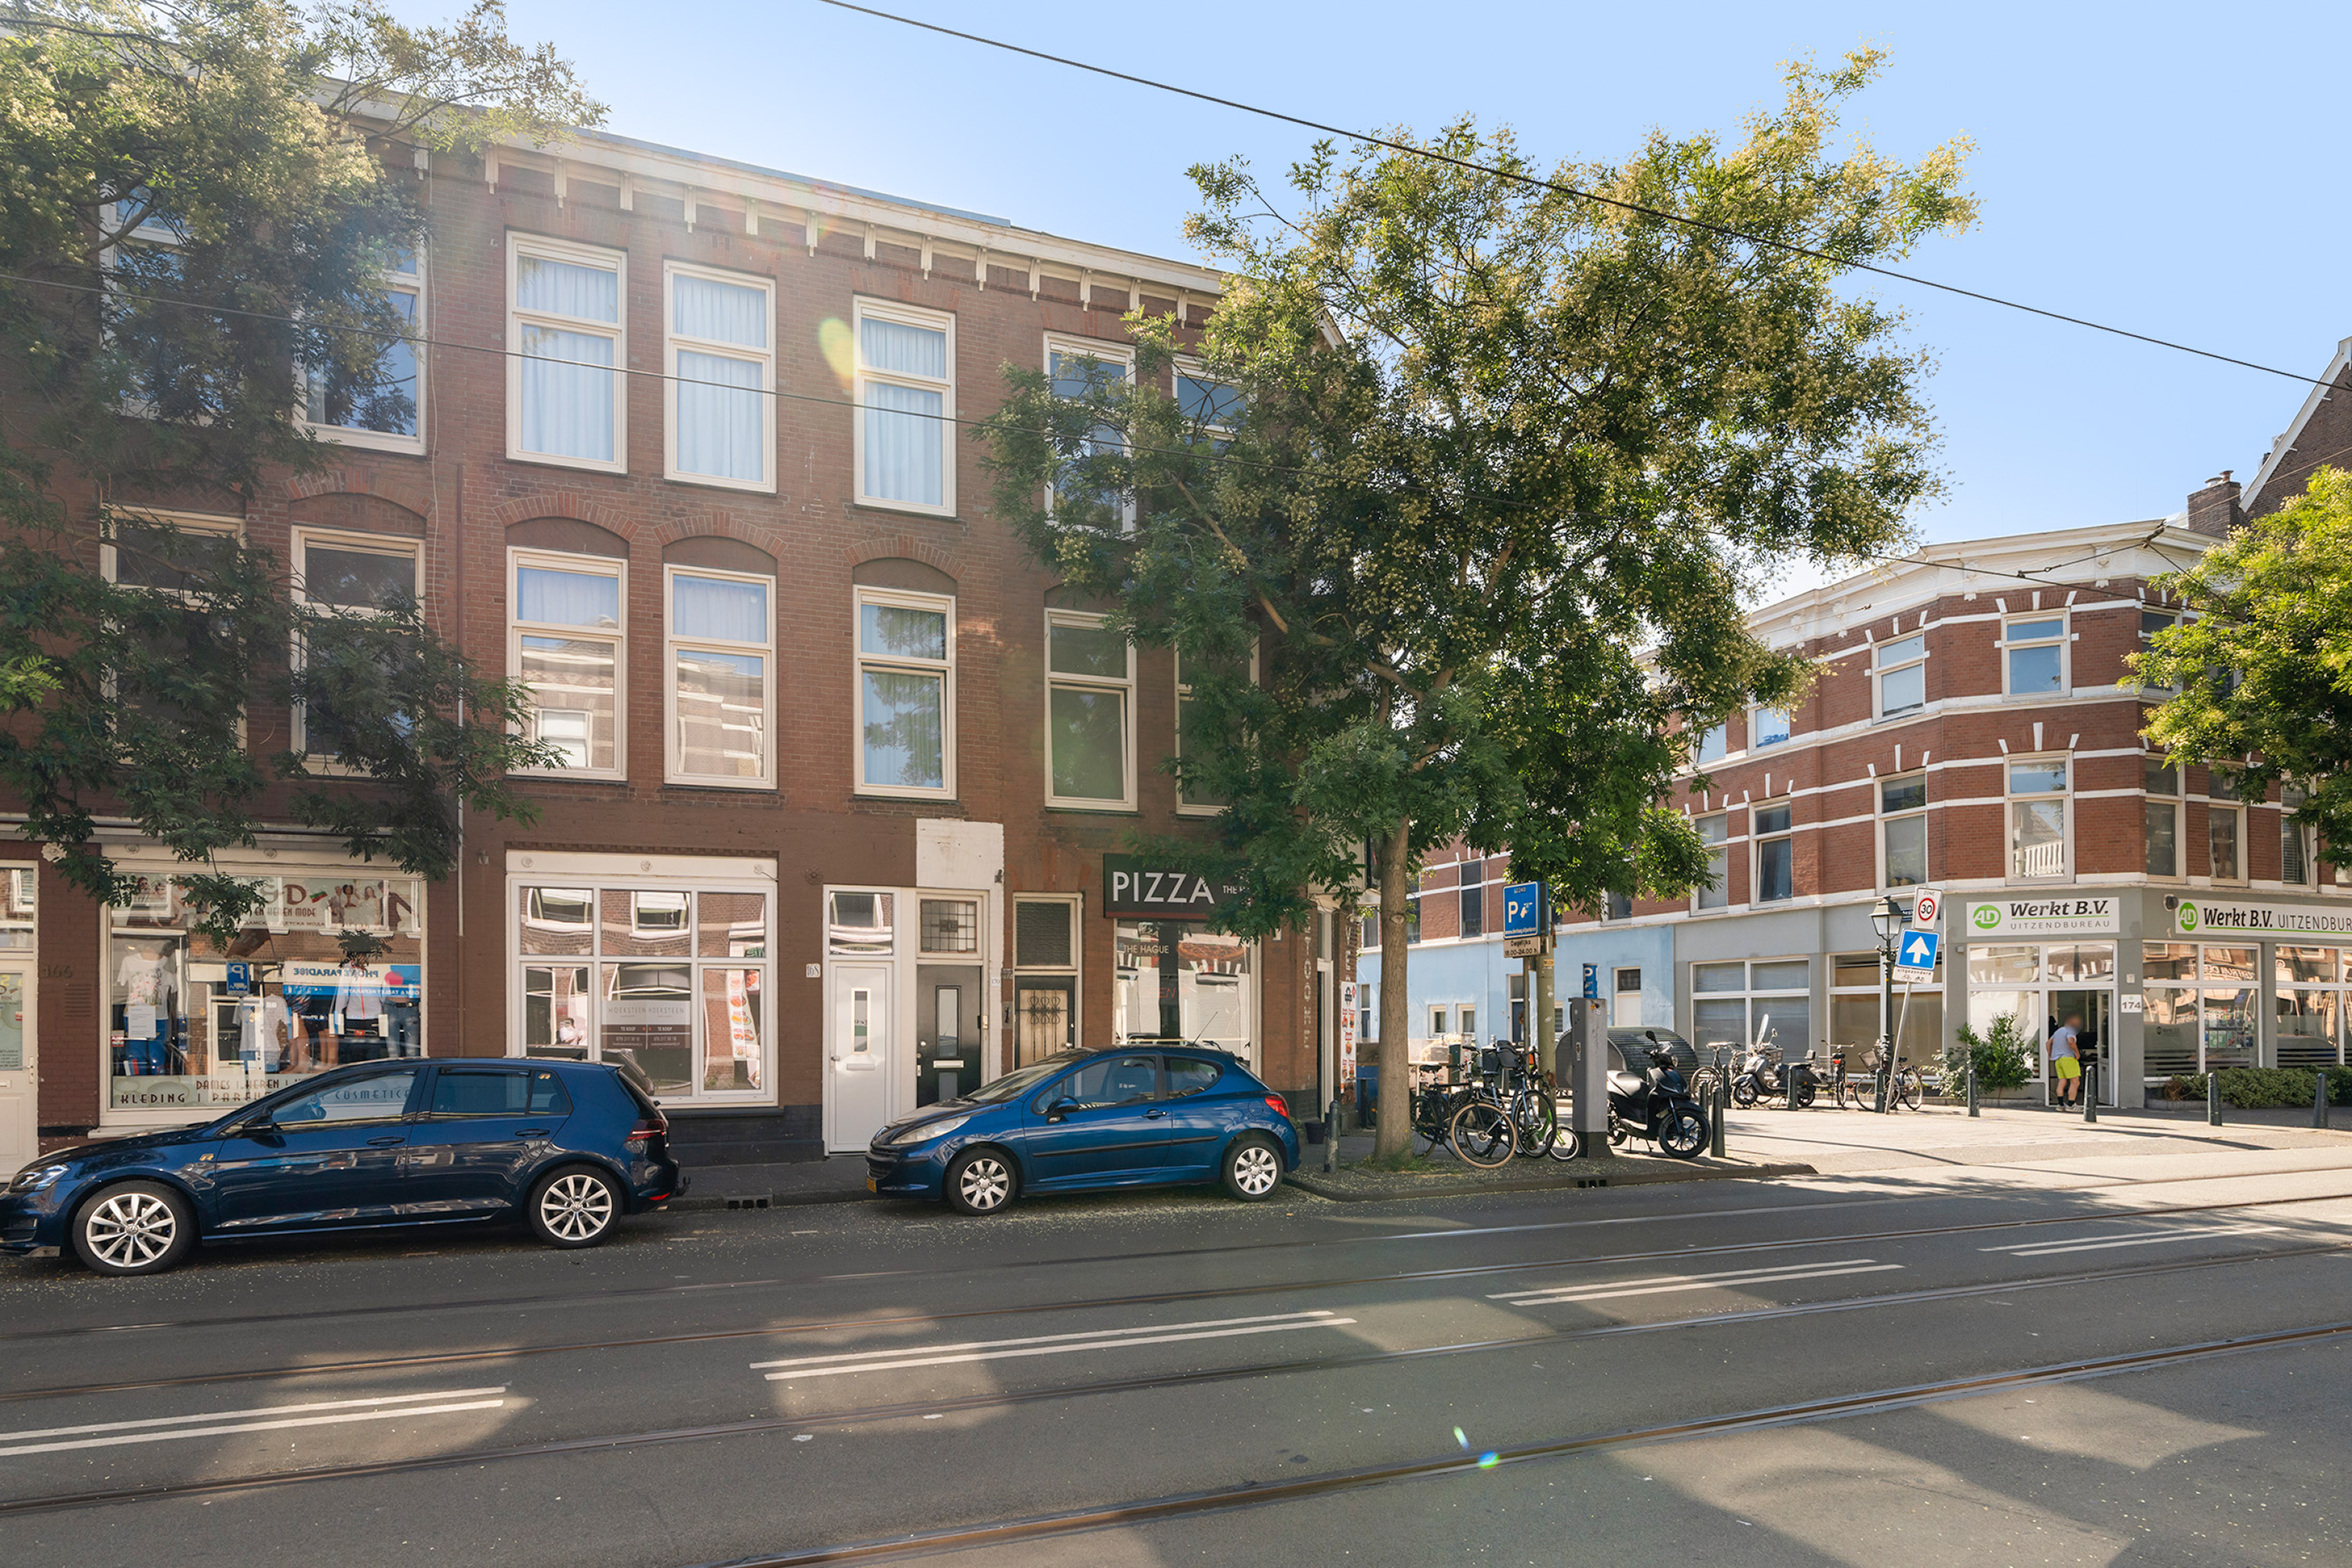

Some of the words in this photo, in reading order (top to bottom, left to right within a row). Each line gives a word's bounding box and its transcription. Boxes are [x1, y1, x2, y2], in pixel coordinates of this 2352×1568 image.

[1112, 871, 1215, 904] PIZZA
[1222, 885, 1237, 894] THE
[296, 908, 317, 916] MODE
[1508, 901, 1519, 923] P
[1920, 904, 1933, 914] 30
[2009, 901, 2071, 916] Werkt
[2074, 900, 2109, 915] B.V.
[2204, 907, 2247, 927] Werkt
[2249, 909, 2274, 928] B.V.
[2010, 920, 2111, 931] UITZENDBUREAU
[1123, 945, 1138, 953] THE
[1141, 945, 1169, 954] HAGUE
[43, 965, 73, 978] 166
[807, 965, 819, 976] 168
[196, 1080, 230, 1090] DAMES
[245, 1079, 279, 1089] HEREN
[120, 1093, 185, 1104] KLEDING
